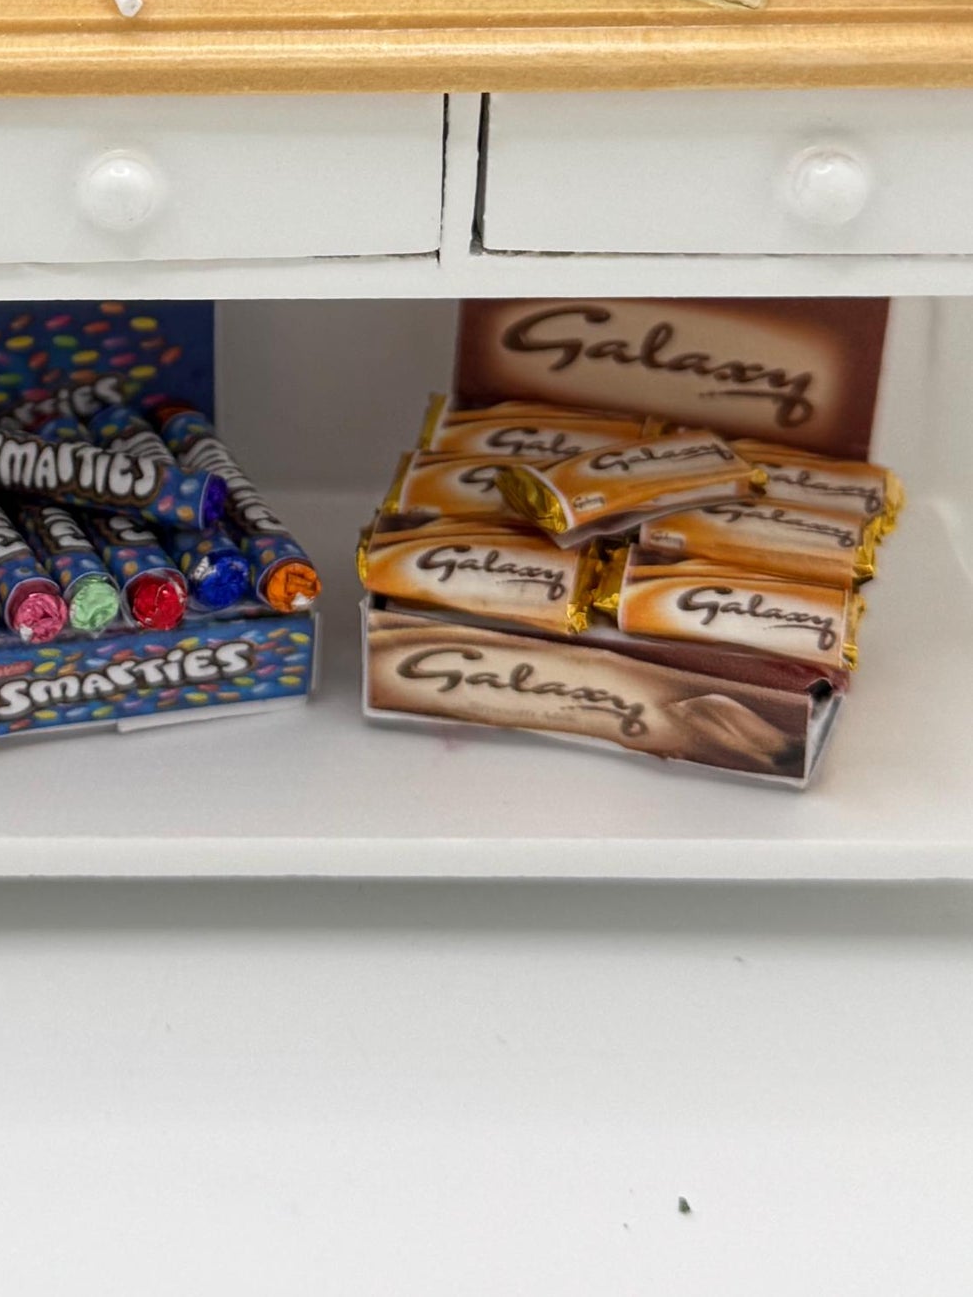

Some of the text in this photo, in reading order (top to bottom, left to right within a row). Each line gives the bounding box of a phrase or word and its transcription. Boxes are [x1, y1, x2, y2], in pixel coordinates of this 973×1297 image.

[502, 305, 815, 429] Galaxy
[588, 441, 735, 472] Galaxy
[765, 469, 883, 515] alaxy
[415, 544, 567, 602] Galaxy
[677, 585, 837, 652] Galaxy
[396, 646, 649, 738] Galaxy
